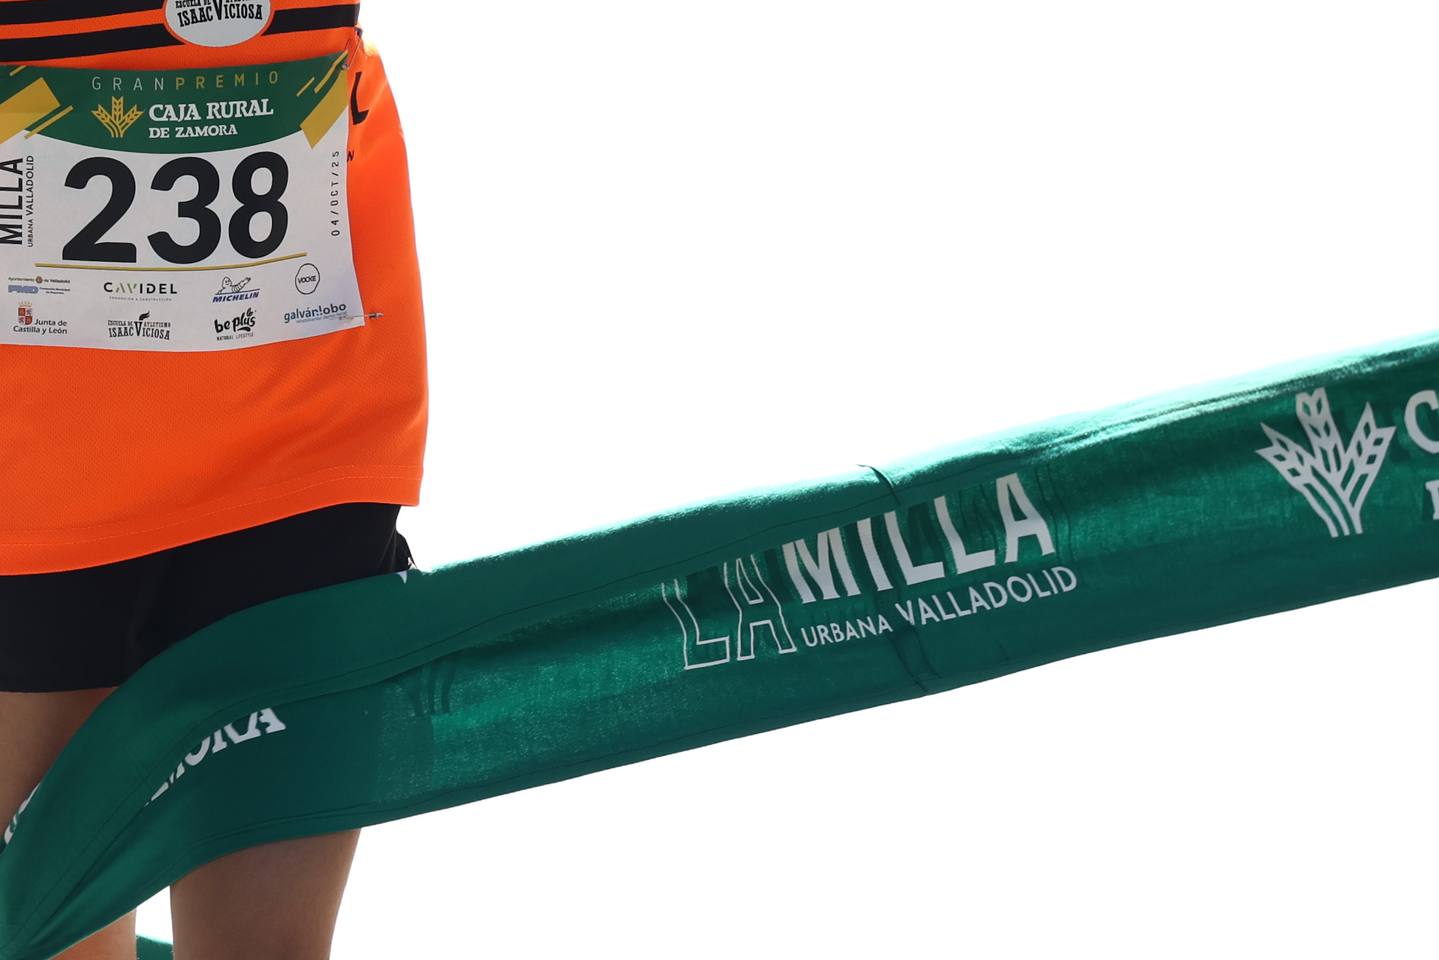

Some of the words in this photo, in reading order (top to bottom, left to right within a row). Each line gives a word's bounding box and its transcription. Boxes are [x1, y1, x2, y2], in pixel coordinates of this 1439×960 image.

[177, 6, 214, 28] ISAAC
[149, 103, 202, 123] CAJA
[206, 98, 274, 120] RURAL
[149, 127, 170, 139] DE
[175, 124, 239, 139] ZAMORA
[25, 155, 35, 217] VALLADOLID
[330, 151, 340, 237] 04/OCT/25
[62, 151, 289, 265] 238
[103, 282, 178, 294] CAVIDEL
[212, 292, 260, 303] MICHELIN
[13, 325, 40, 333] Castilla
[42, 327, 47, 335] y
[48, 327, 68, 335] León
[108, 327, 134, 338] ISAAC
[133, 321, 171, 341] VICIOSA
[214, 319, 231, 334] be
[232, 312, 256, 333] plus
[661, 554, 798, 670] LA
[782, 473, 1057, 604] MILLA
[800, 615, 893, 648] URBANA
[895, 566, 1078, 627] VALLADOLID
